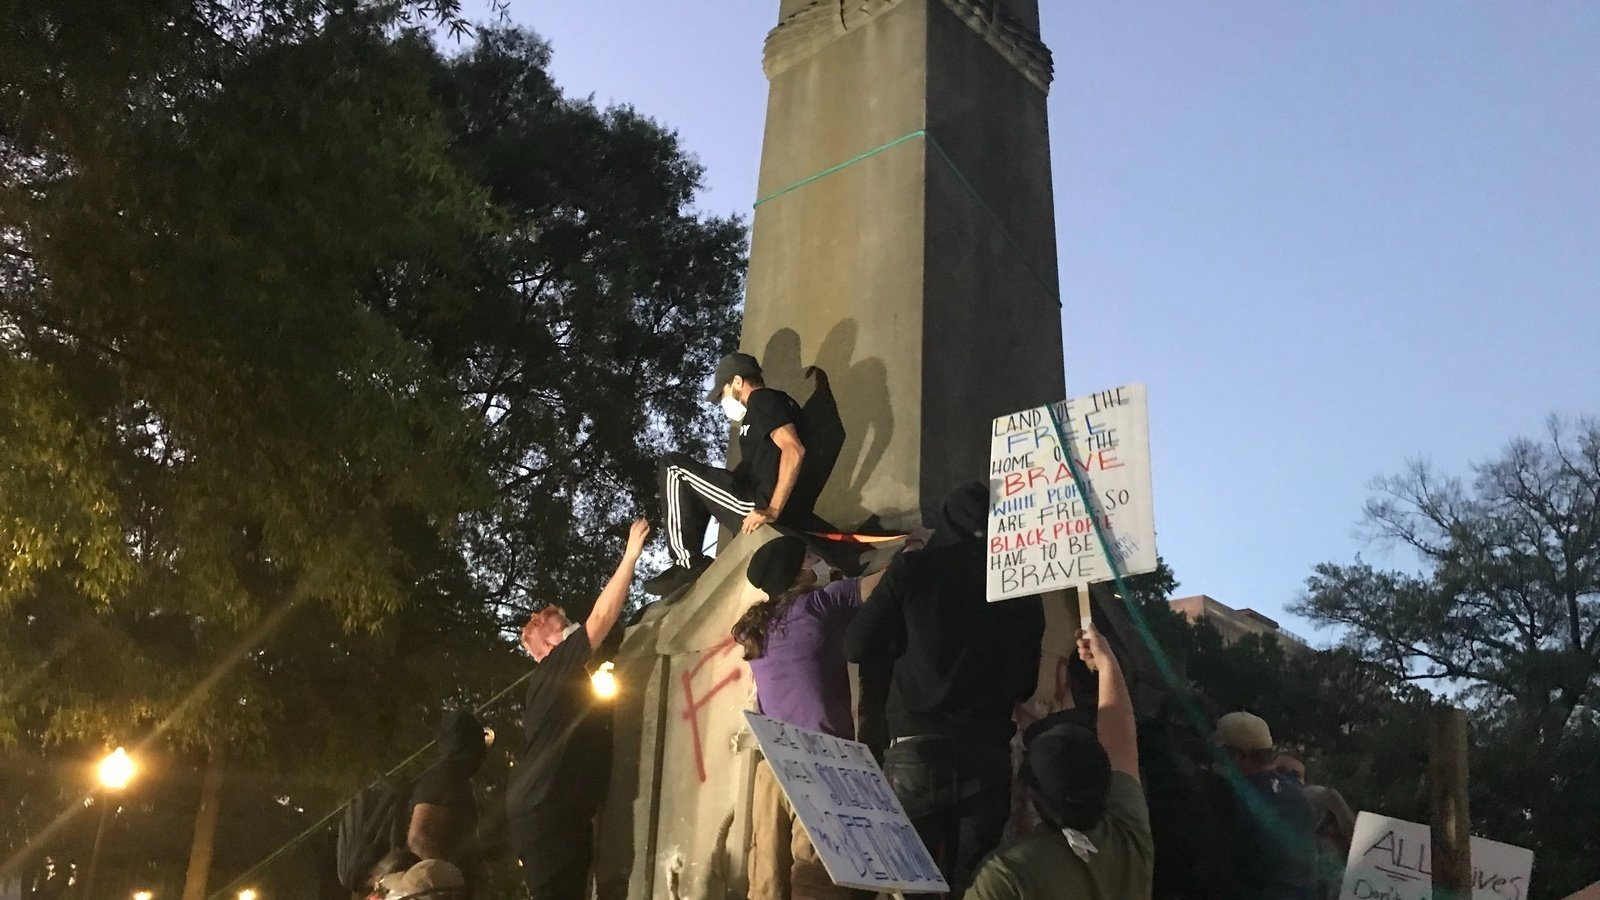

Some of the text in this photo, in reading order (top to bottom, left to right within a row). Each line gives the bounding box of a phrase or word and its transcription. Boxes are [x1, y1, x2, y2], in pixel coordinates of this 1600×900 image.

[994, 386, 1130, 437] LAND OF THE
[991, 451, 1035, 475] HOME
[1085, 428, 1120, 451] THE
[1005, 447, 1126, 496] BRAVE
[993, 489, 1036, 517] WHITE
[997, 513, 1027, 534] ARE
[1104, 488, 1129, 511] SO
[990, 527, 1049, 554] BLACK
[990, 547, 1028, 571] HAVE
[1068, 533, 1094, 555] BE
[1001, 554, 1095, 594] BRAVE
[1363, 830, 1523, 900] ALL ives
